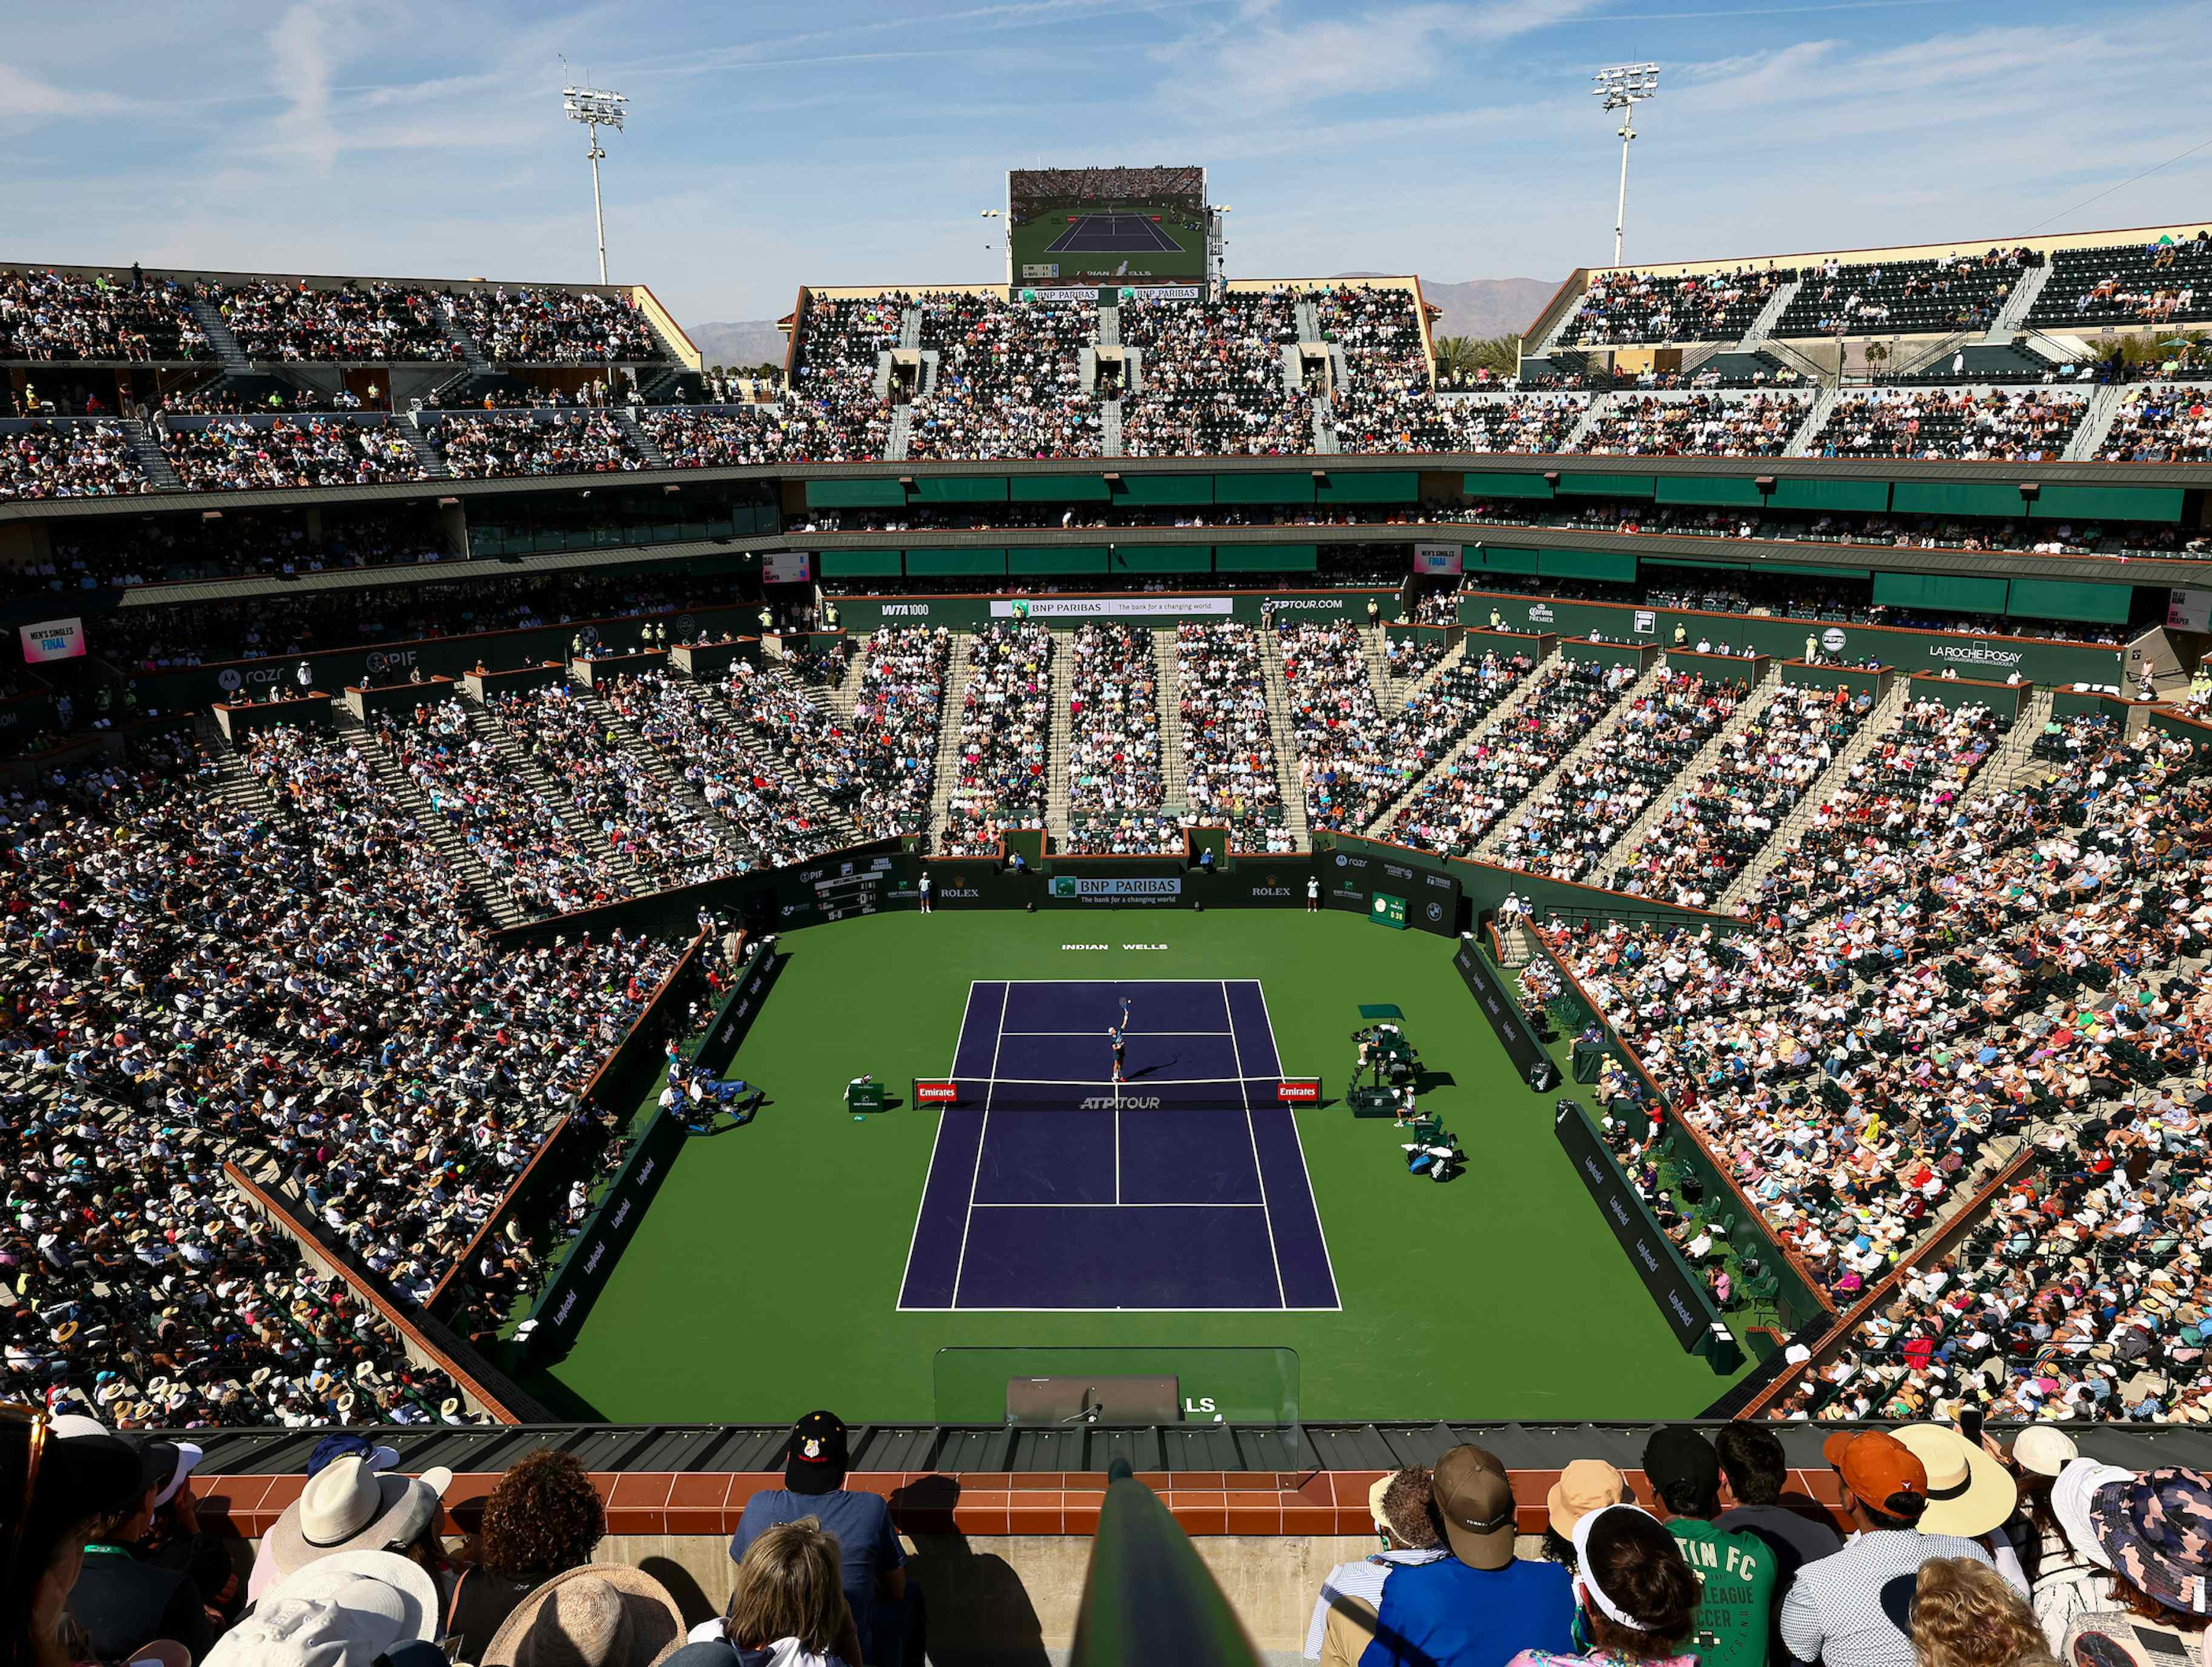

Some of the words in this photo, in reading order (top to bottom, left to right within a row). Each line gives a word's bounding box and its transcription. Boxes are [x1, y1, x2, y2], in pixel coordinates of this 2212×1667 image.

[1158, 289, 1195, 298] PARIBAS
[1429, 557, 1445, 566] FINAL
[1529, 607, 1553, 617] Corona
[2168, 616, 2189, 625] DRAPER
[30, 630, 48, 640] MEN'S
[49, 627, 73, 637] SINGLES
[42, 637, 67, 650] FINAL
[389, 650, 417, 667] PIF
[1930, 646, 1944, 656] LA
[1945, 647, 1984, 659] ROCHE
[1985, 650, 2022, 663] POSAY
[2116, 652, 2122, 661] 1
[245, 668, 285, 684] razr
[128, 679, 136, 687] 6
[1348, 858, 1367, 868] razr
[810, 870, 824, 880] PIF
[1081, 880, 1110, 892] BNP
[1116, 880, 1175, 892] PARIBAS
[1252, 887, 1291, 896] ROLEX
[919, 1088, 955, 1097] Emirates
[1279, 1087, 1316, 1096] Emirates
[1079, 1097, 1115, 1109] ATP
[1118, 1097, 1161, 1109] TOUR
[611, 1198, 631, 1229] Laykold
[1609, 1195, 1630, 1227] Laykold
[583, 1241, 605, 1275] Laykold
[1636, 1238, 1659, 1272] Laykold
[553, 1288, 578, 1326] Laykold
[1668, 1289, 1694, 1328] Laykold
[1184, 1398, 1216, 1412] LS
[1726, 1546, 1756, 1581] FC
[1704, 1586, 1754, 1605] LEAGUE
